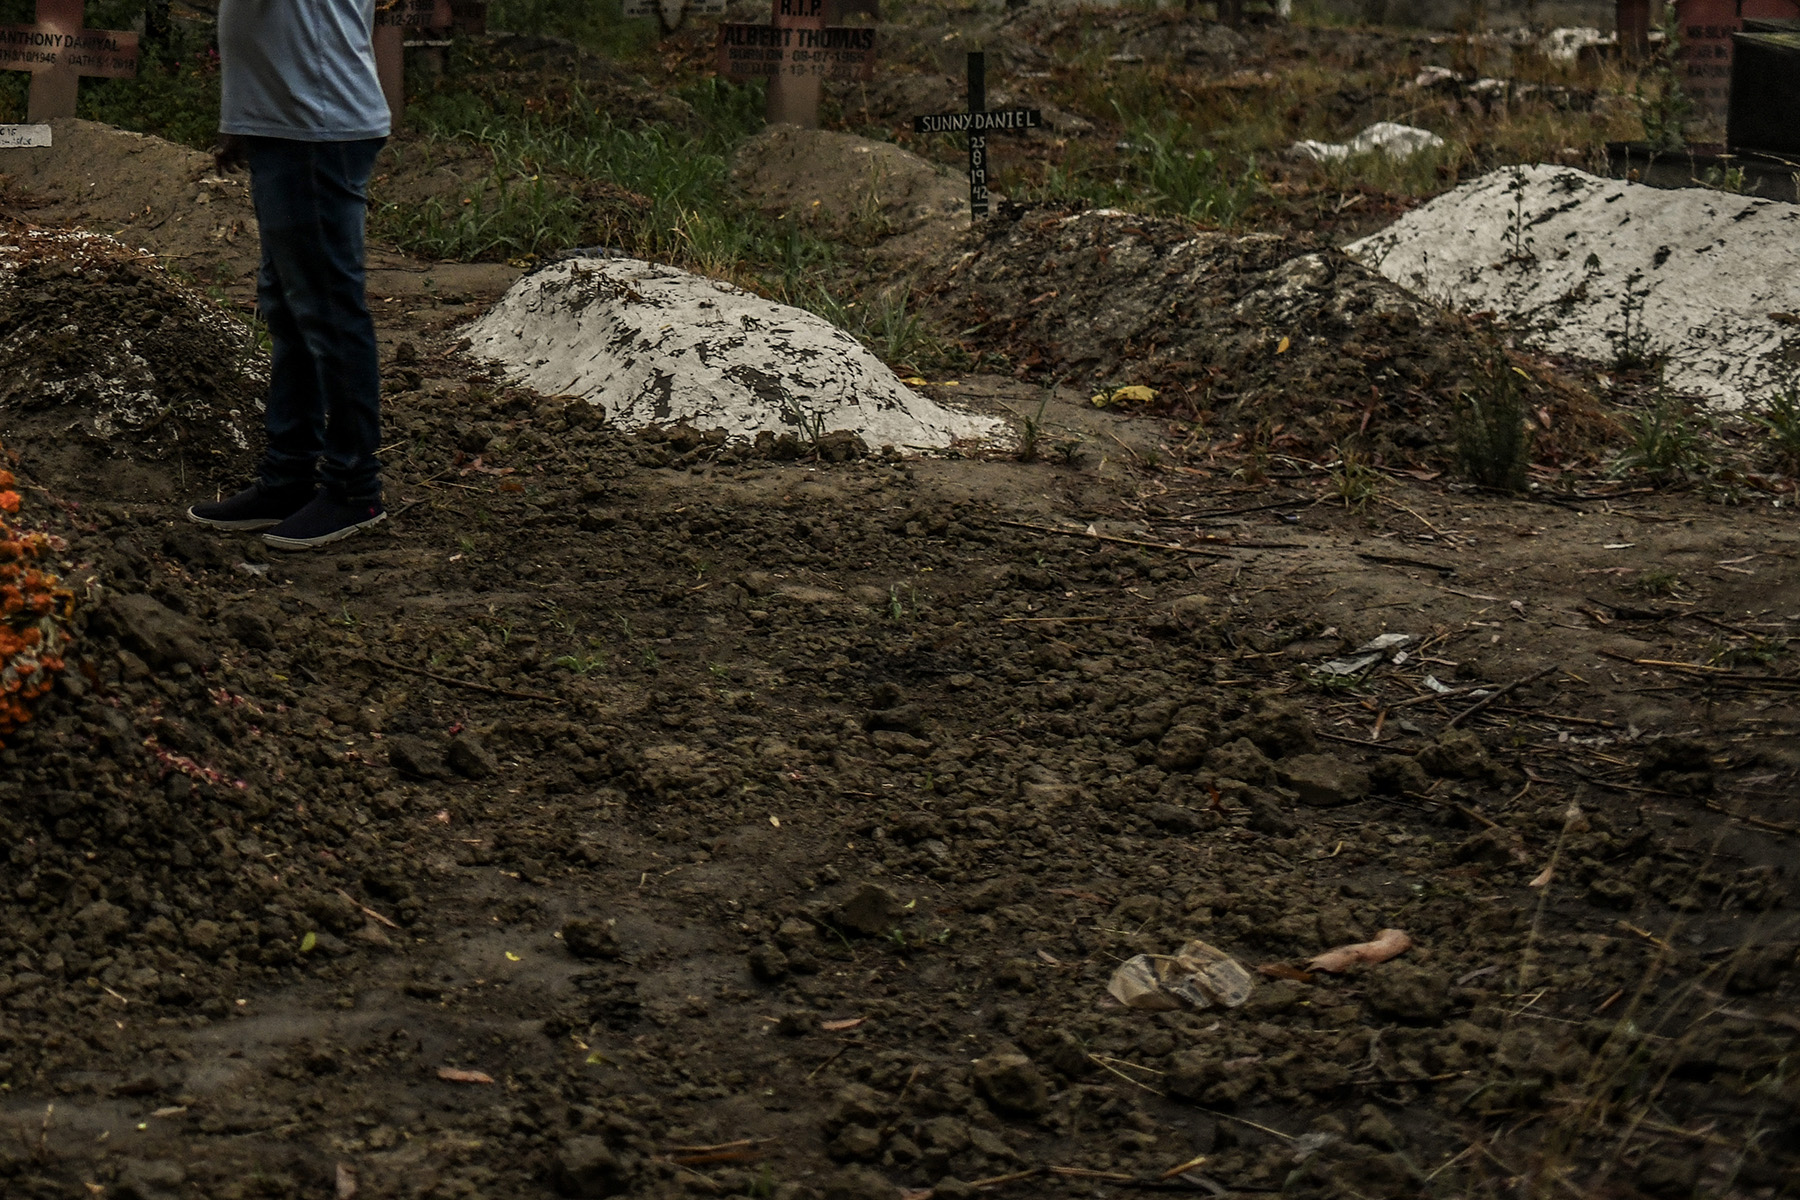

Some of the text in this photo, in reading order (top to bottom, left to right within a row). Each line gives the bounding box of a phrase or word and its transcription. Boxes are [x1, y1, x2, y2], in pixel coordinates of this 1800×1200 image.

[724, 26, 875, 50] ALBERT THOMAS
[970, 136, 986, 149] 25
[971, 169, 985, 185] 19
